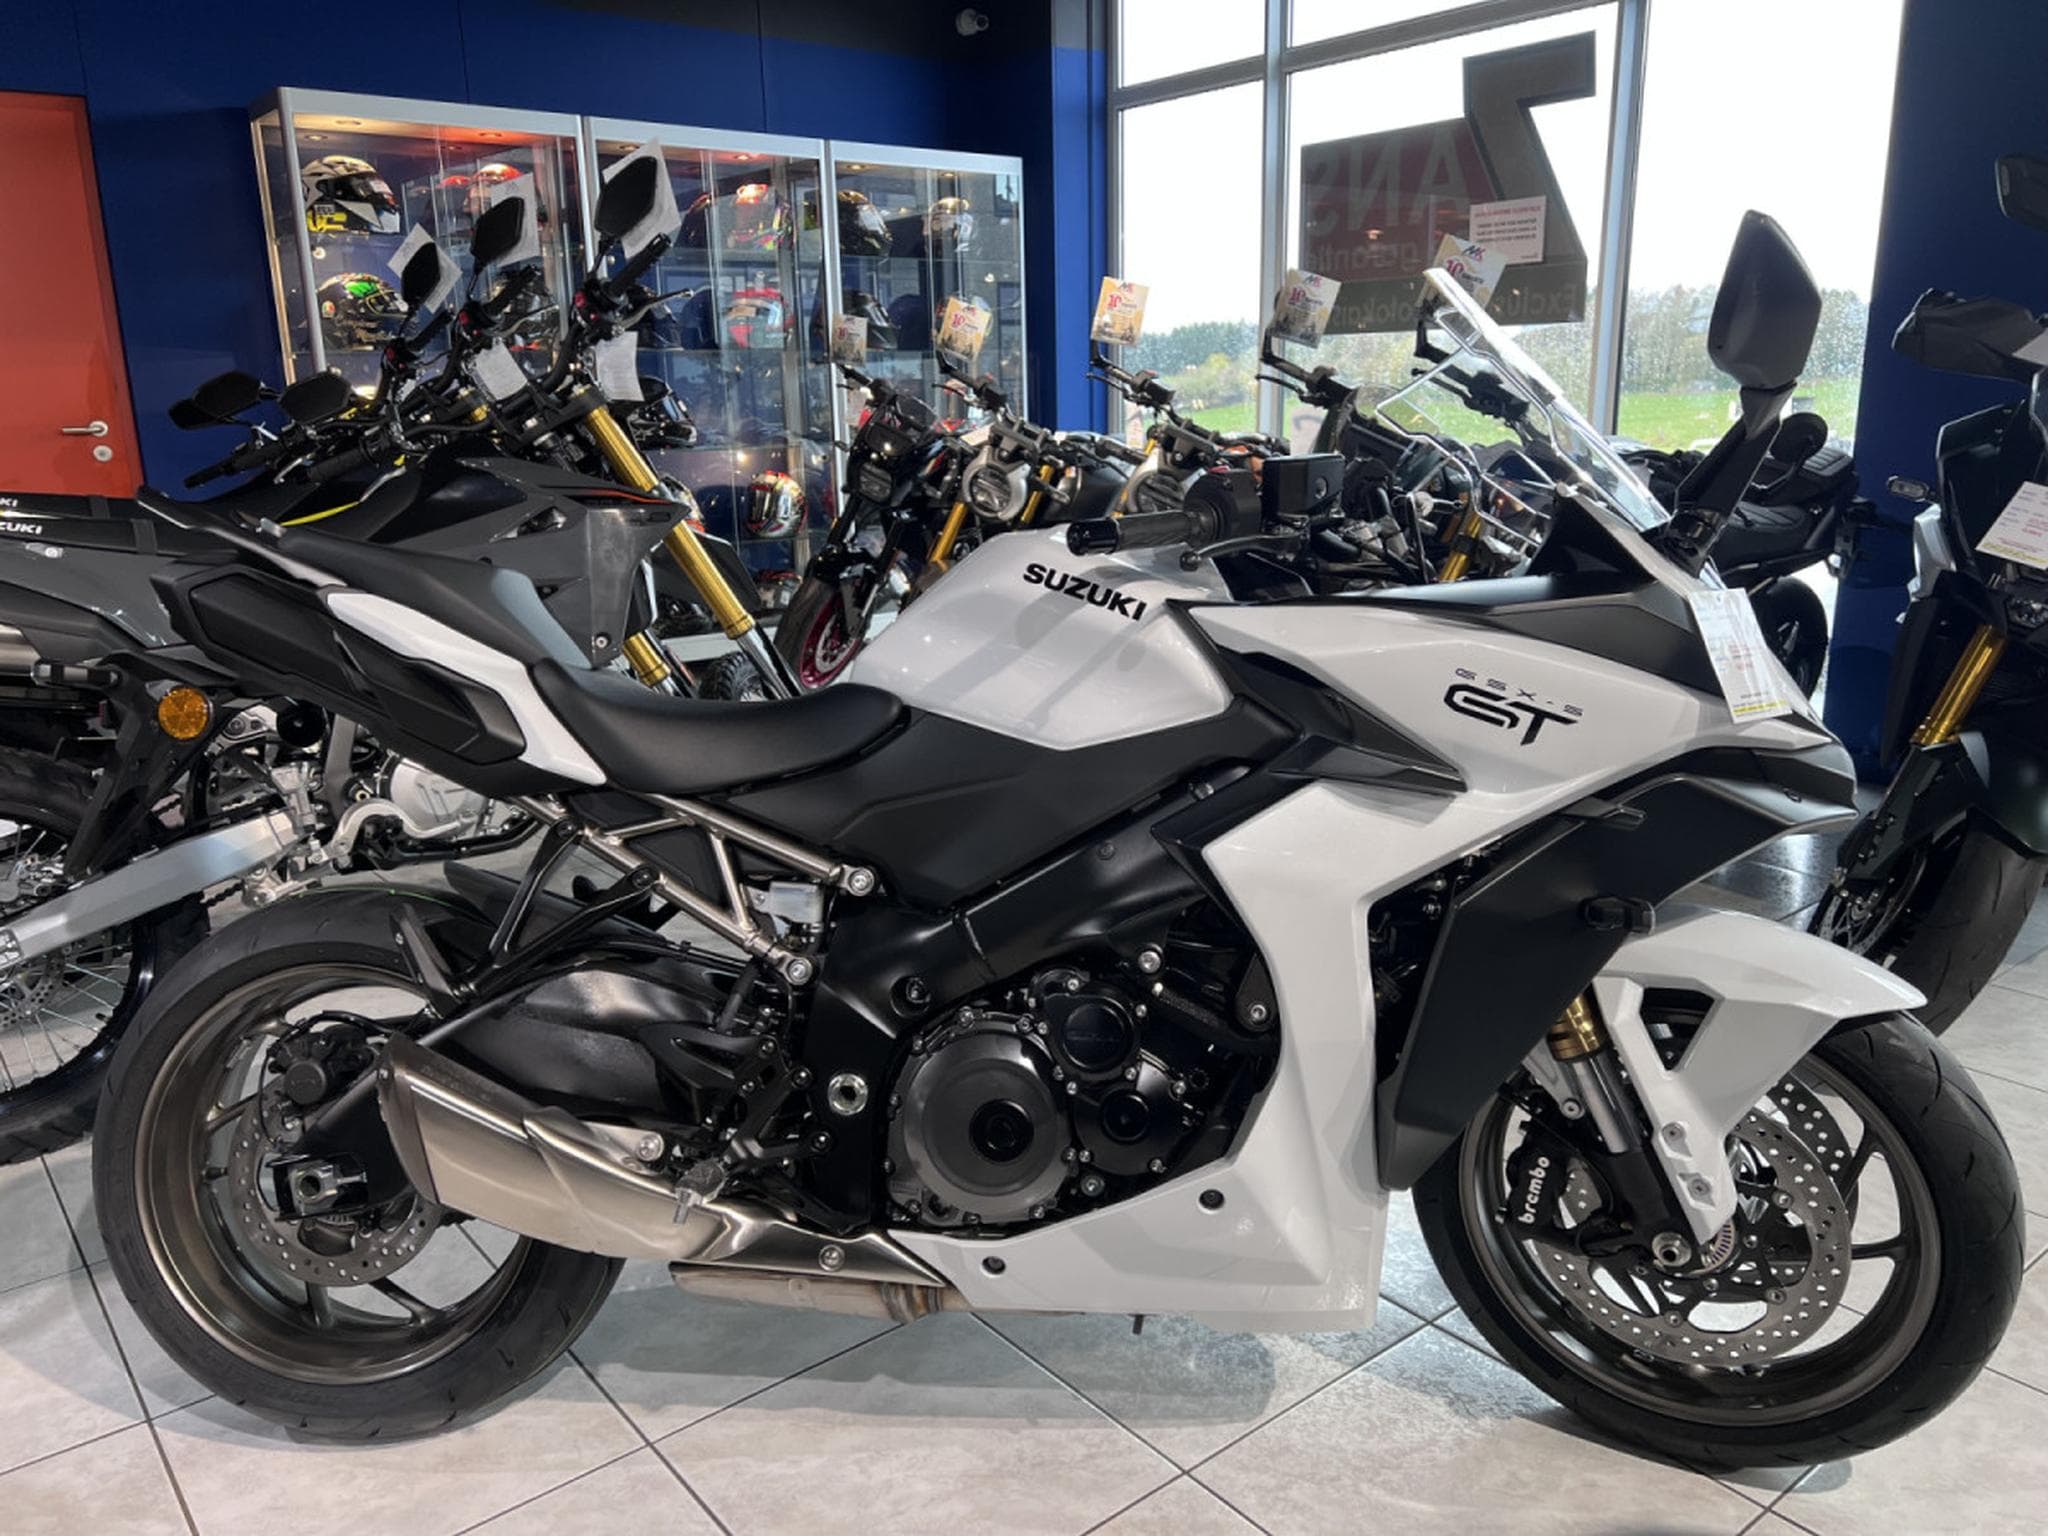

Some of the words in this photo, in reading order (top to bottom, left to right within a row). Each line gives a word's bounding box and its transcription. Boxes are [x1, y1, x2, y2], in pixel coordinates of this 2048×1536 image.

[1023, 563, 1147, 621] SUZUKI
[1444, 684, 1578, 746] GT
[1517, 1156, 1551, 1225] brembo
